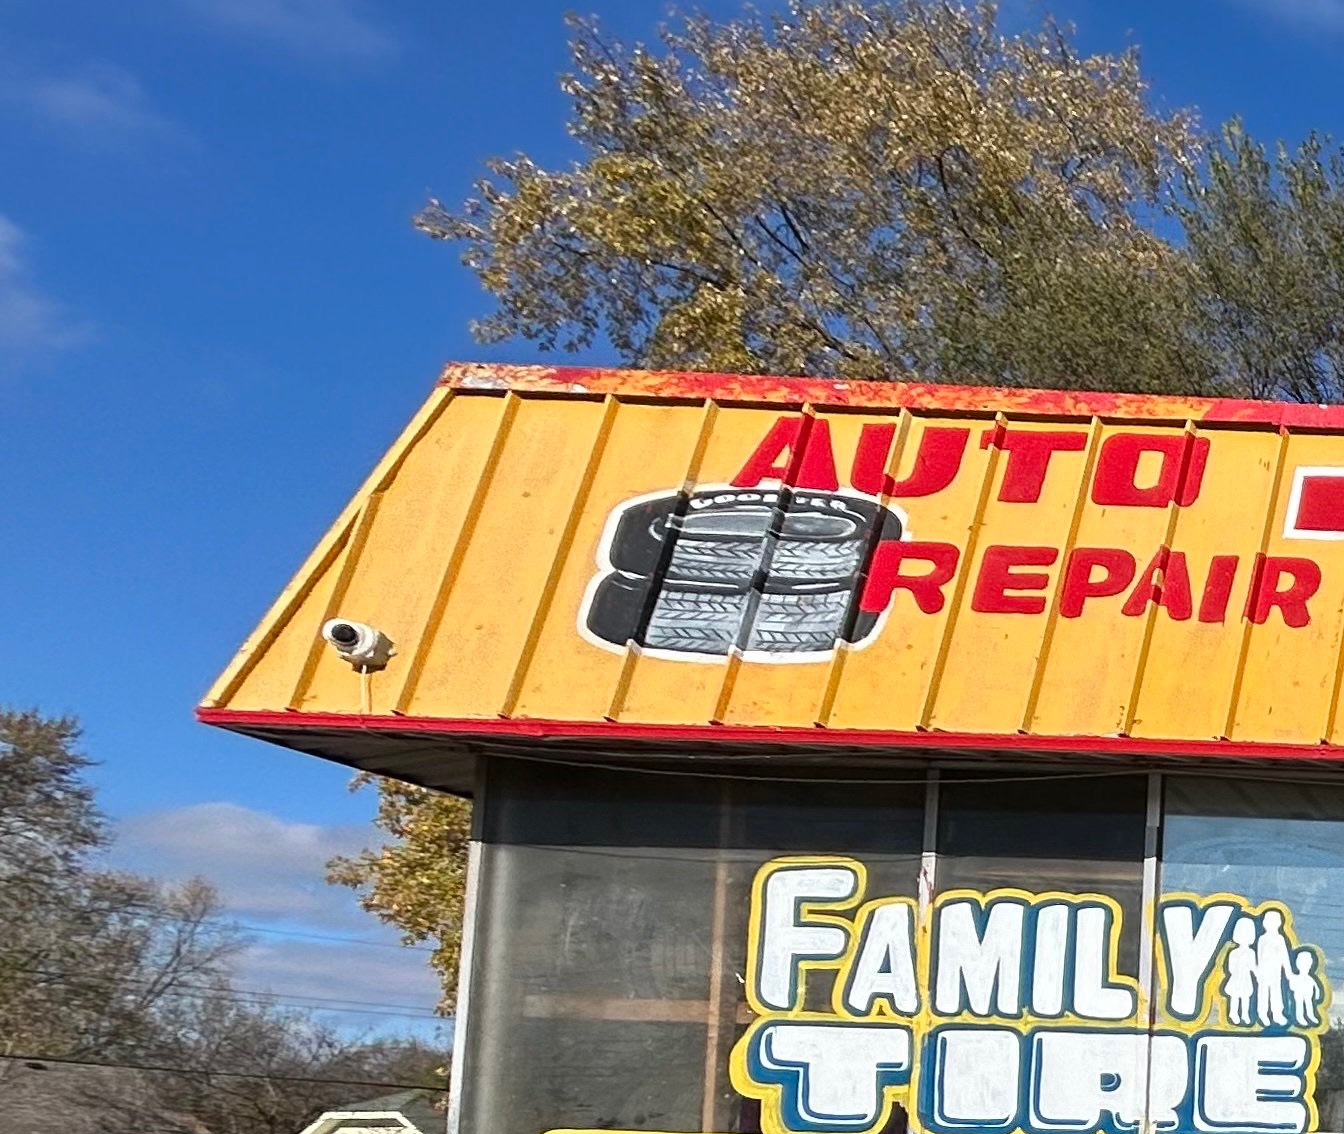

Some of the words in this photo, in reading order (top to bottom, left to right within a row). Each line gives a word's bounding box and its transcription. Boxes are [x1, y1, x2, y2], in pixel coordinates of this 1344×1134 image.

[730, 414, 1211, 508] AUTO
[859, 539, 1323, 630] REPAIR
[752, 858, 1240, 1022] FAMILY
